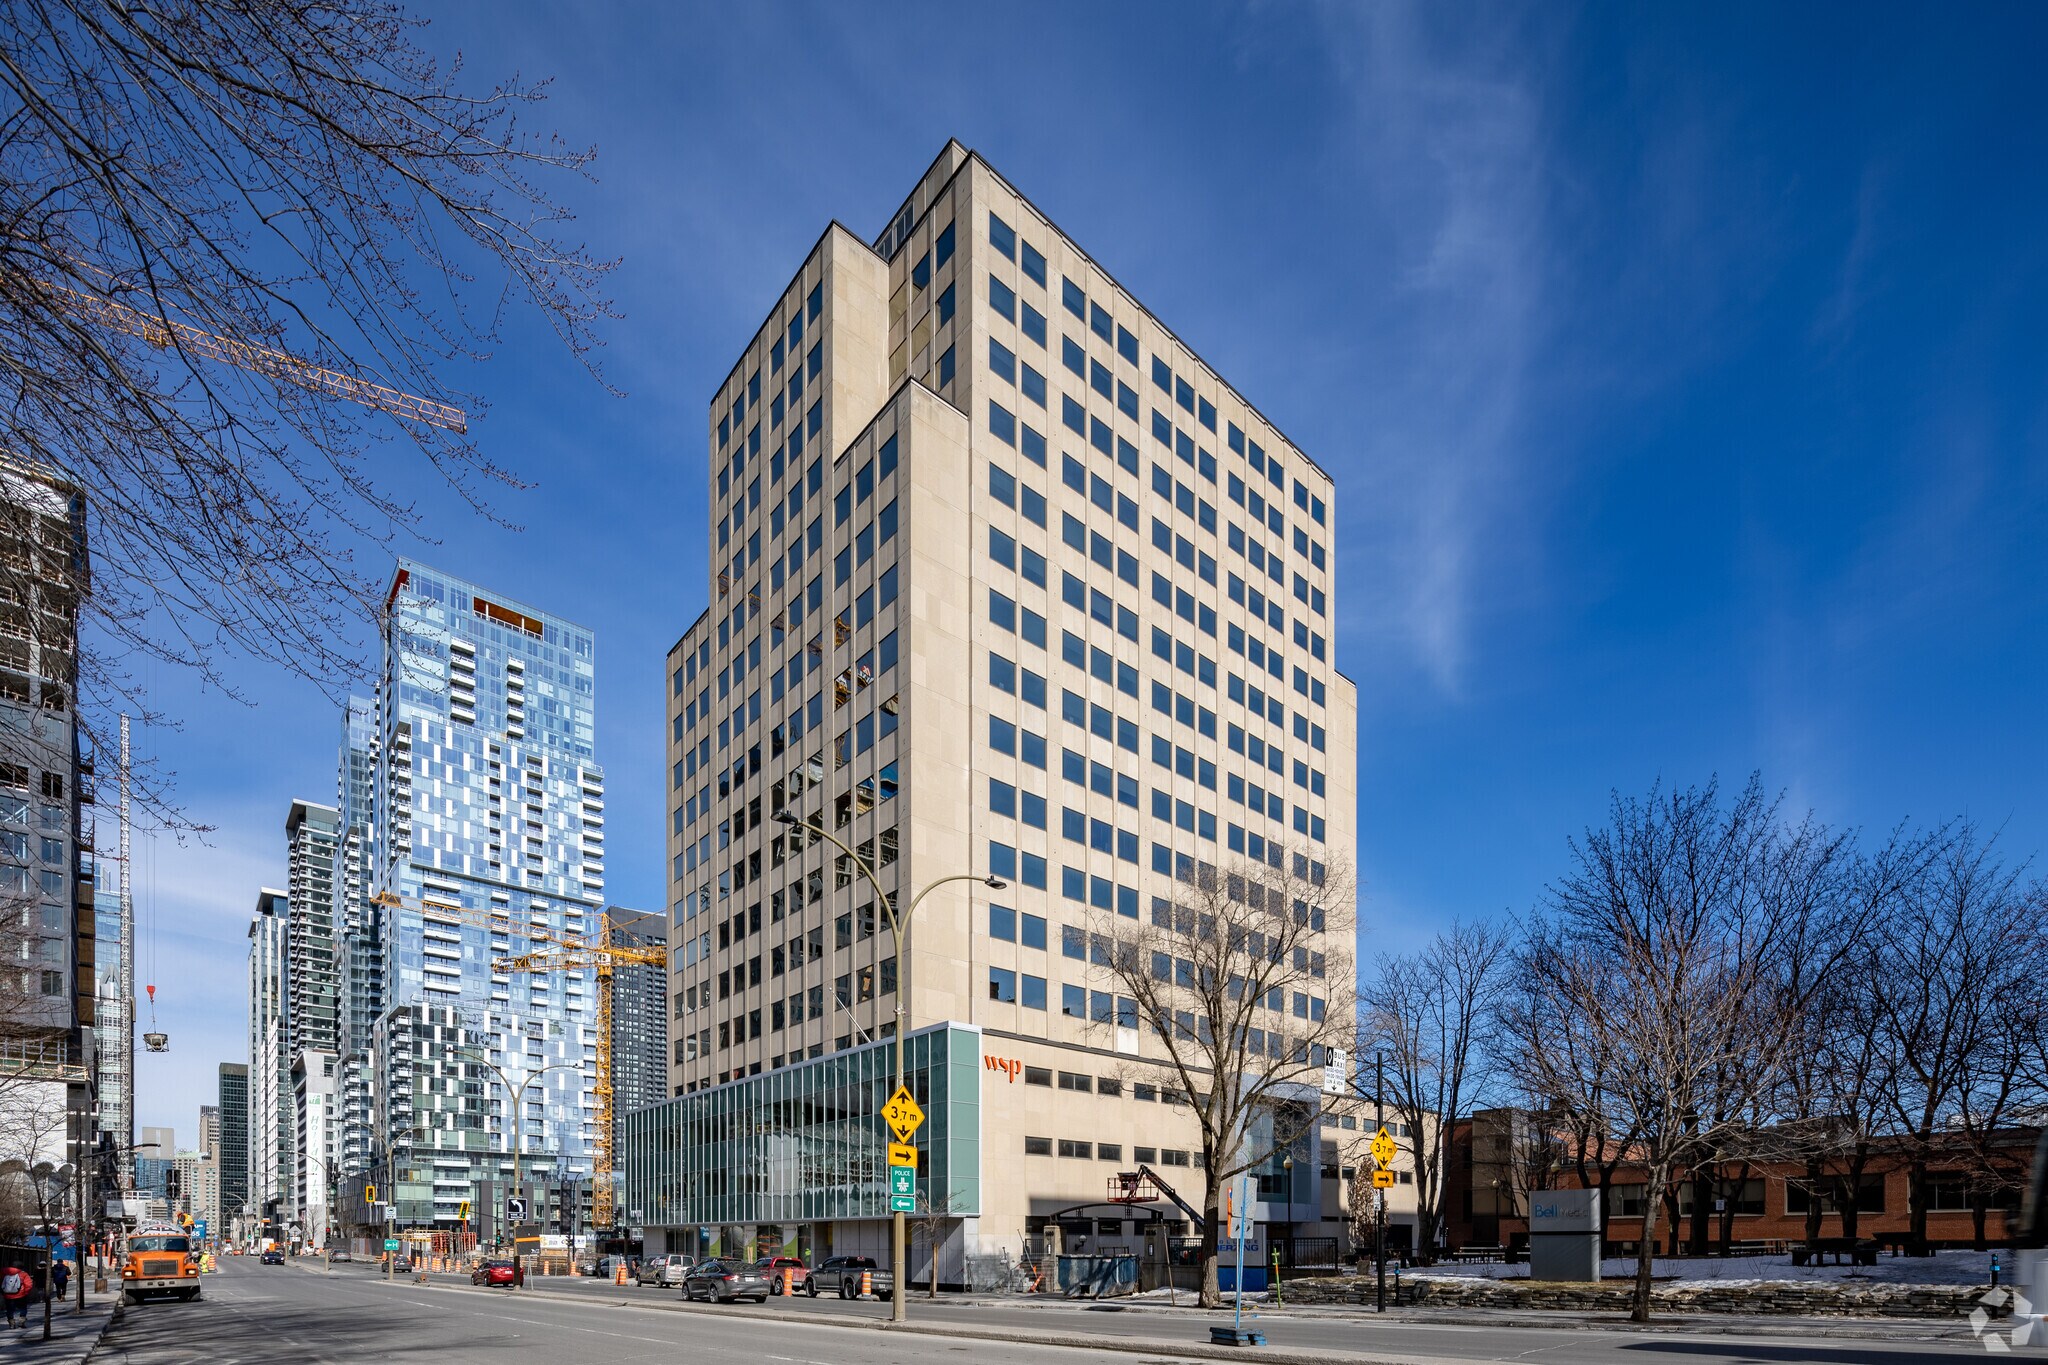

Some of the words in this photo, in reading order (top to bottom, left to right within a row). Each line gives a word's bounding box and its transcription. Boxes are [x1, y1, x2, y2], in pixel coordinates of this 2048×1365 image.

[1334, 1051, 1345, 1060] BUS
[984, 1055, 1022, 1083] wsp
[1334, 1061, 1345, 1069] TAXI
[1535, 1204, 1558, 1218] Bell
